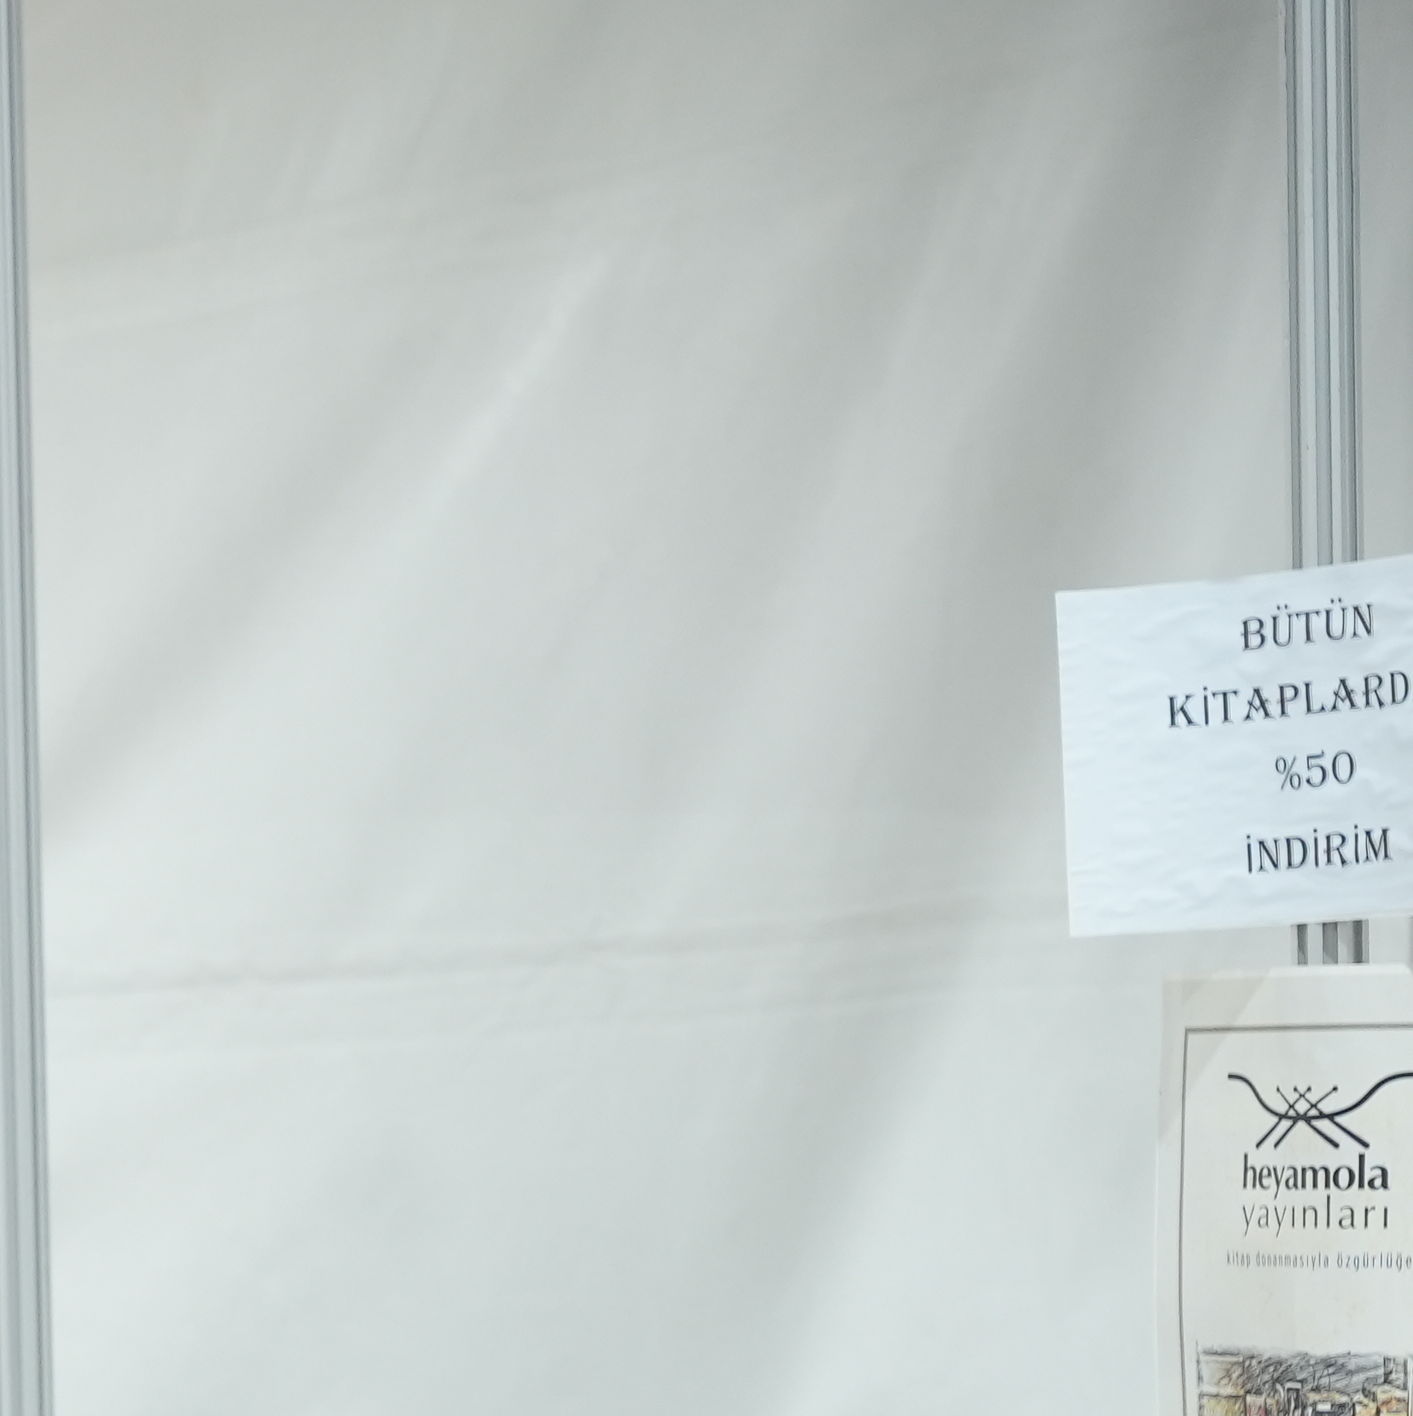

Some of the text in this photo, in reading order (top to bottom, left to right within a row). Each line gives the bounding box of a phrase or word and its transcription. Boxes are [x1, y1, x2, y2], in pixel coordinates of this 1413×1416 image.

[1240, 597, 1375, 652] BÜTÜN
[1274, 749, 1357, 791] %50
[1245, 823, 1394, 875] İNDİRİM
[1242, 1152, 1391, 1201] heyamola
[1242, 1194, 1389, 1238] yayınları
[1226, 1250, 1251, 1270] kitap
